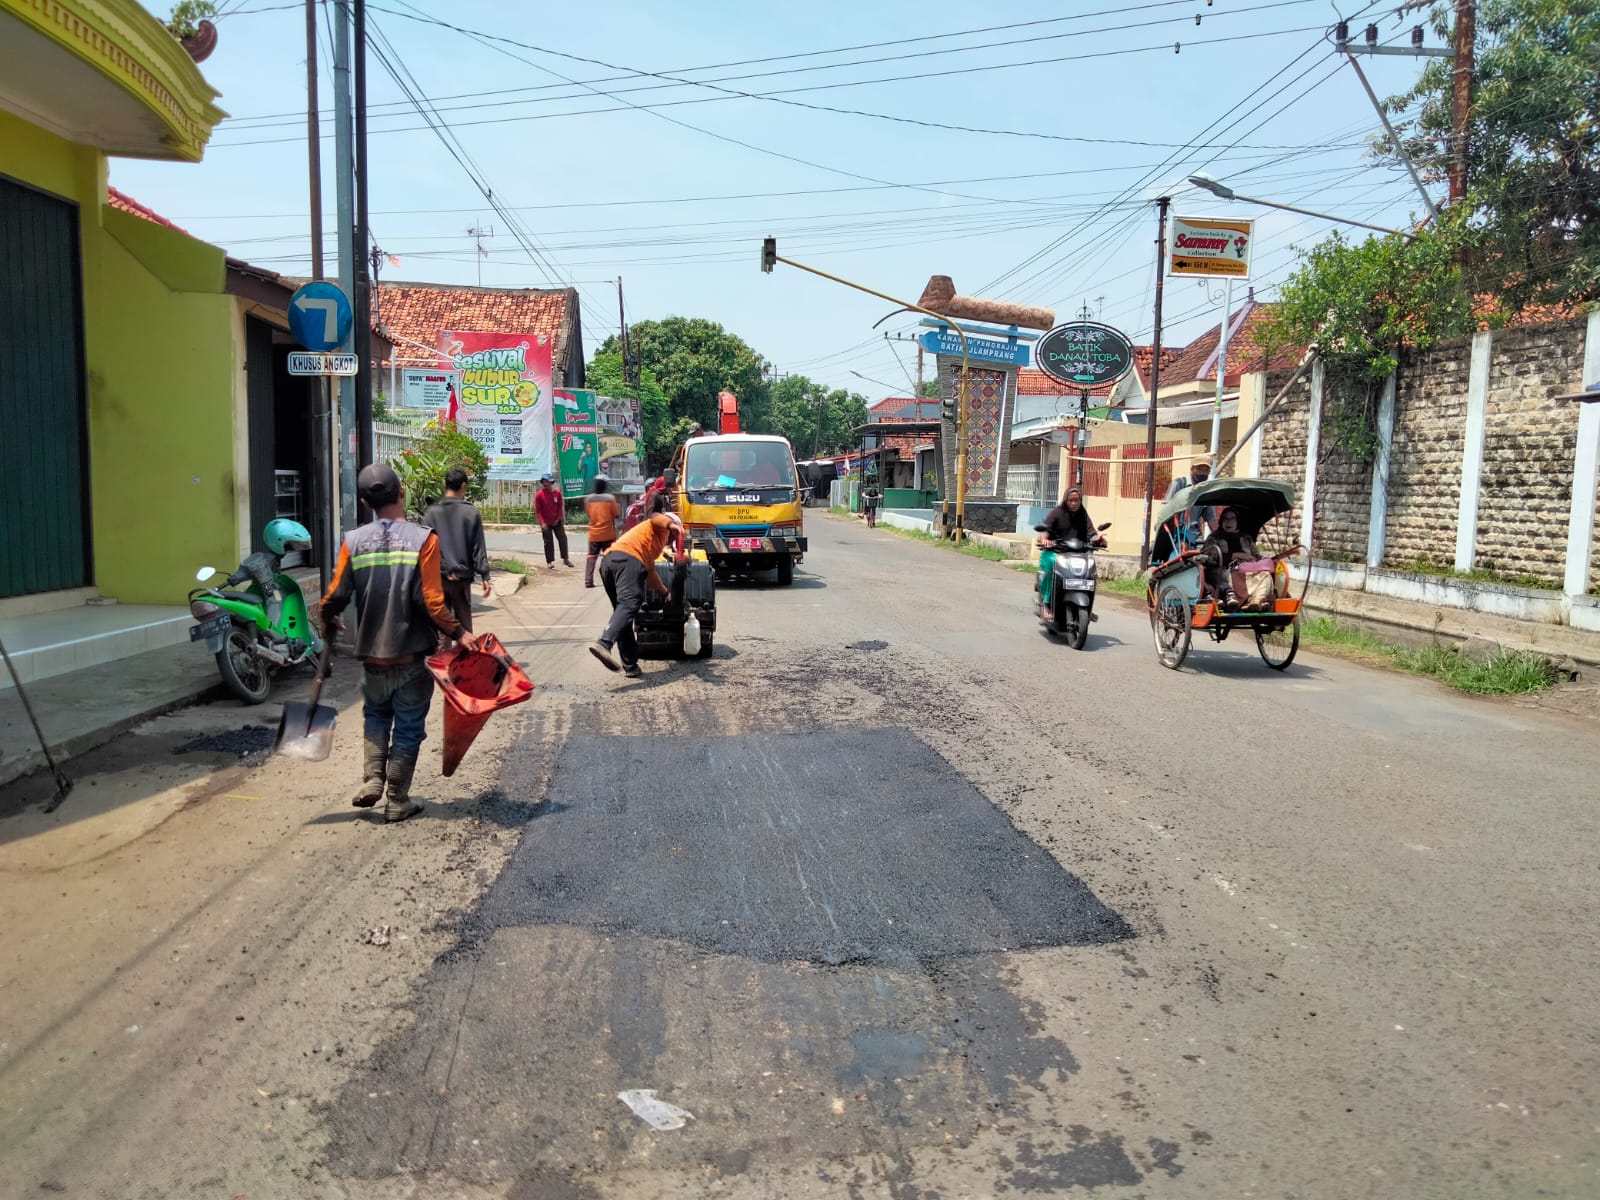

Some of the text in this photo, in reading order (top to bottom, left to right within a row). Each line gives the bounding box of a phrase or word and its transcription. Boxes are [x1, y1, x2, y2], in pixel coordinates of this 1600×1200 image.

[1175, 233, 1230, 253] Sammy
[937, 334, 974, 346] KAWASN
[1068, 342, 1102, 352] BATIK
[969, 347, 1015, 360] JLAMPRANG
[1049, 352, 1121, 363] DANAU TOBA
[292, 356, 354, 371] KHUSUS ANGKOT
[498, 404, 521, 414] 2022
[725, 494, 760, 503] ISUZU
